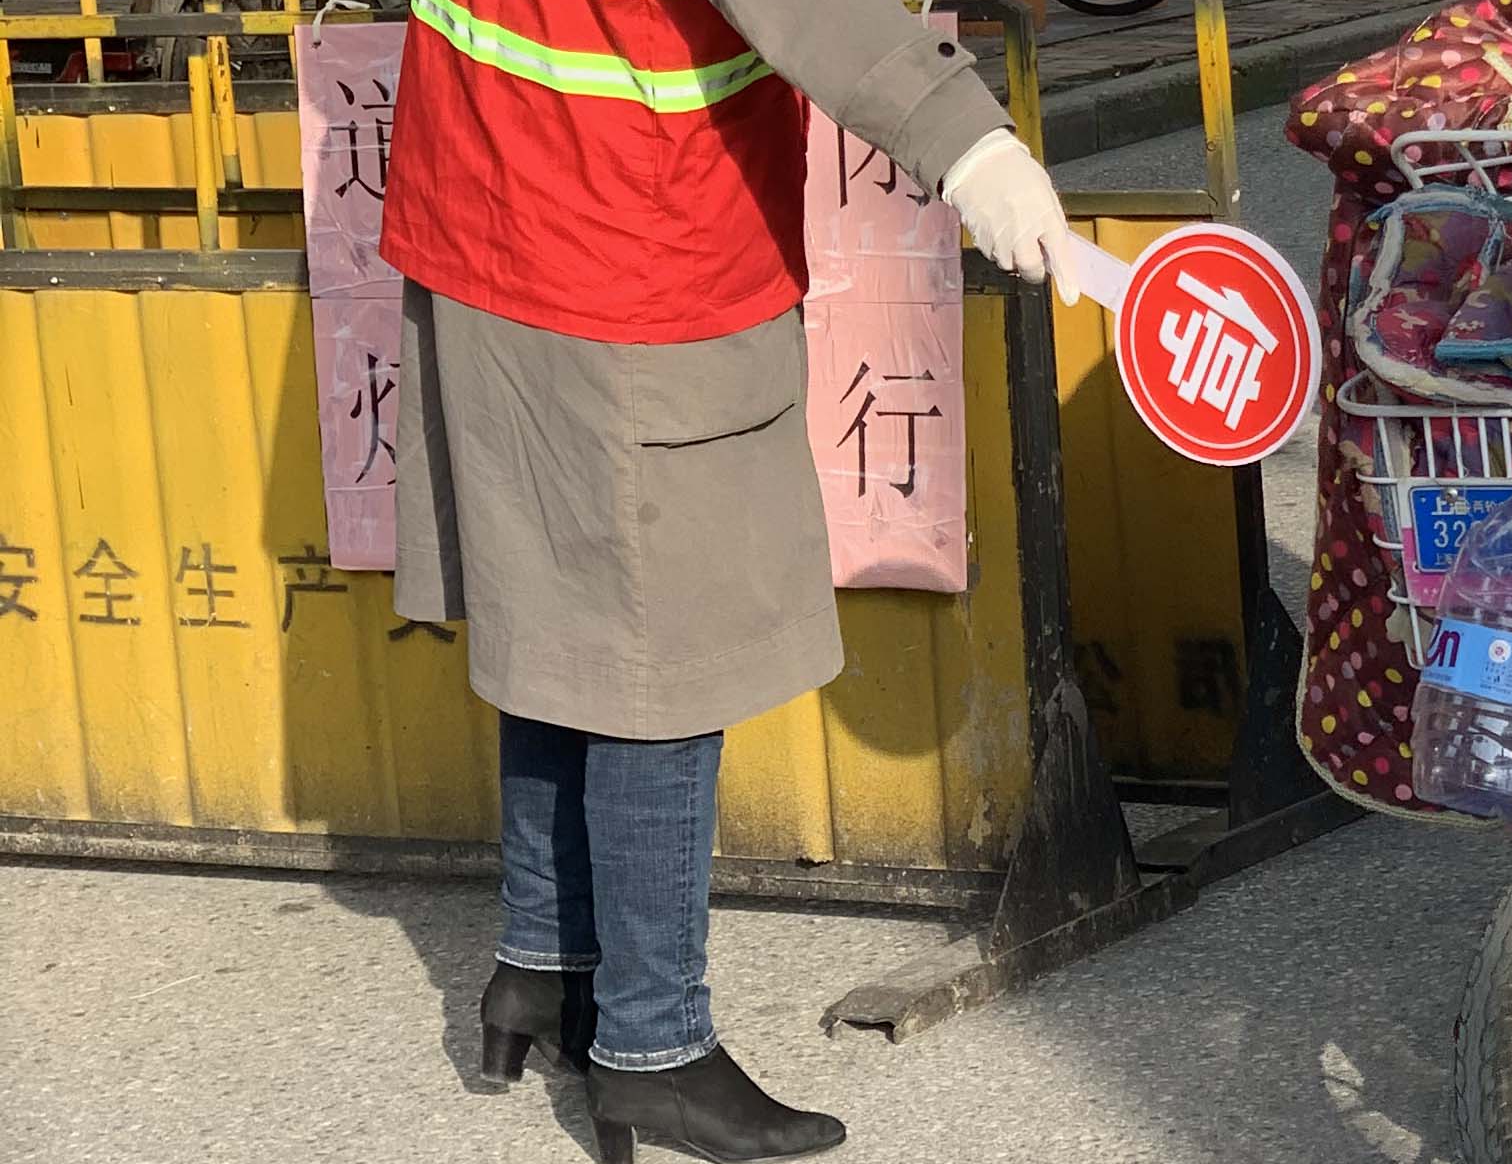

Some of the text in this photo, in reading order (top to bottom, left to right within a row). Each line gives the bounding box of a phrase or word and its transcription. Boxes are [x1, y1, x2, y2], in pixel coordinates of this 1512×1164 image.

[1158, 269, 1281, 431] 停
[0, 538, 456, 642] 安全生产
